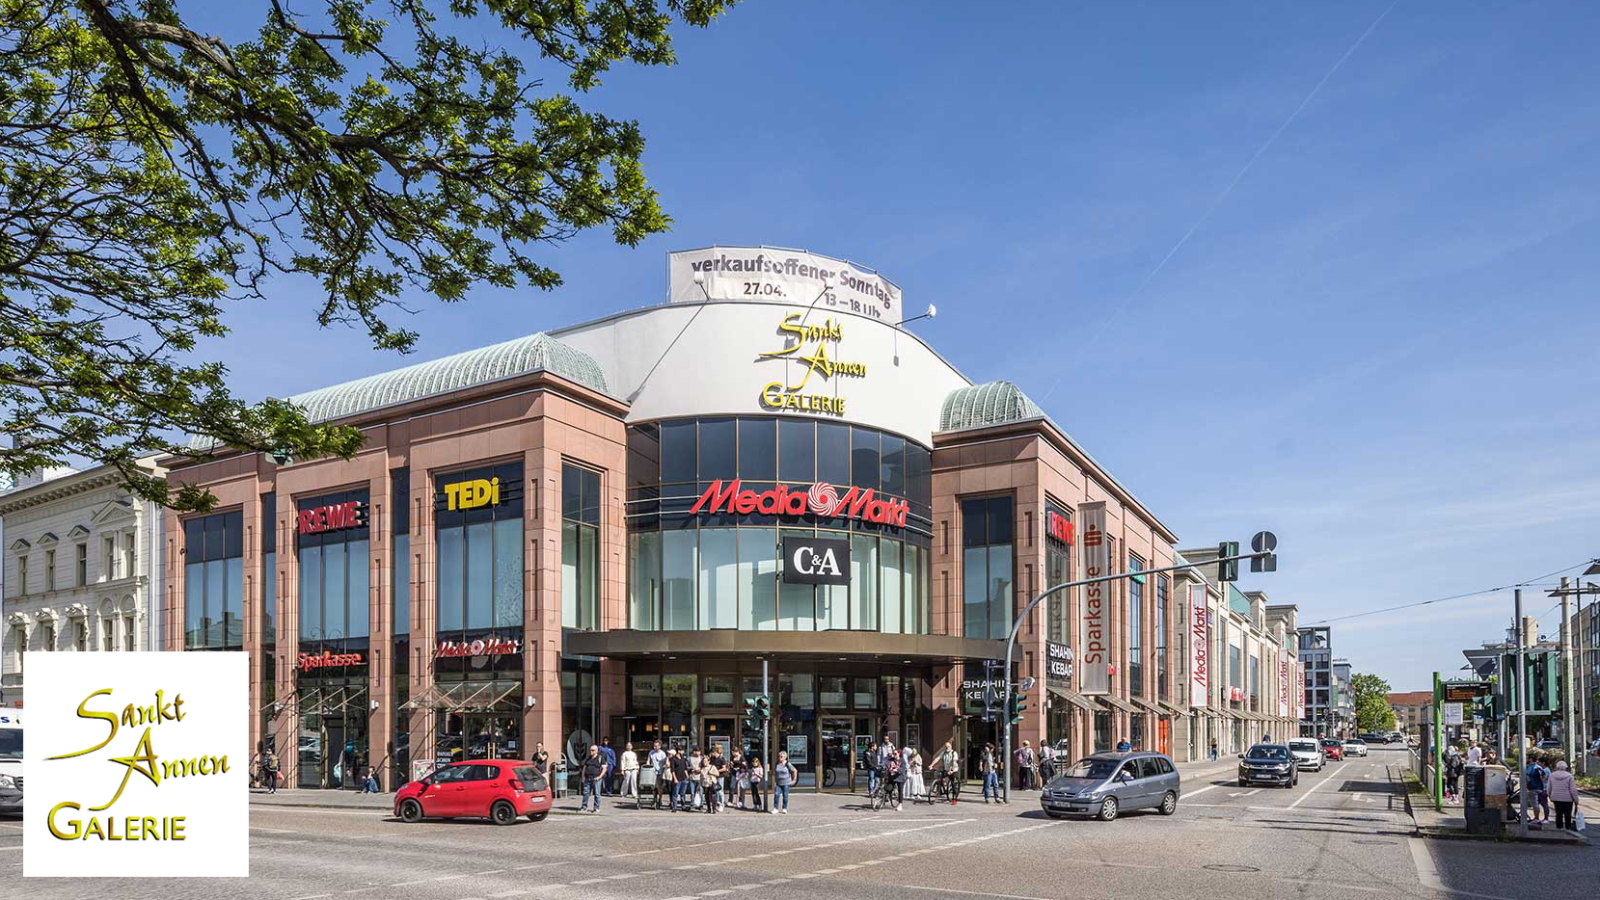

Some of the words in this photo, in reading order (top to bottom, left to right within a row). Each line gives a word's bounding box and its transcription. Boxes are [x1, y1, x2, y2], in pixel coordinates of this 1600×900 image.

[691, 254, 836, 281] verkaufsoffener
[840, 269, 891, 309] Sonntag
[743, 282, 787, 297] 27.04.
[758, 312, 844, 356] Sankt
[786, 339, 868, 391] Annen
[762, 381, 845, 414] GALERIE
[444, 477, 499, 511] TEDi
[690, 478, 807, 516] Media
[833, 485, 910, 527] Markt
[298, 500, 362, 535] REWE
[793, 546, 842, 576] C&A
[1083, 566, 1106, 664] Sparkasse
[1193, 606, 1206, 641] Markt
[1193, 649, 1206, 687] Media
